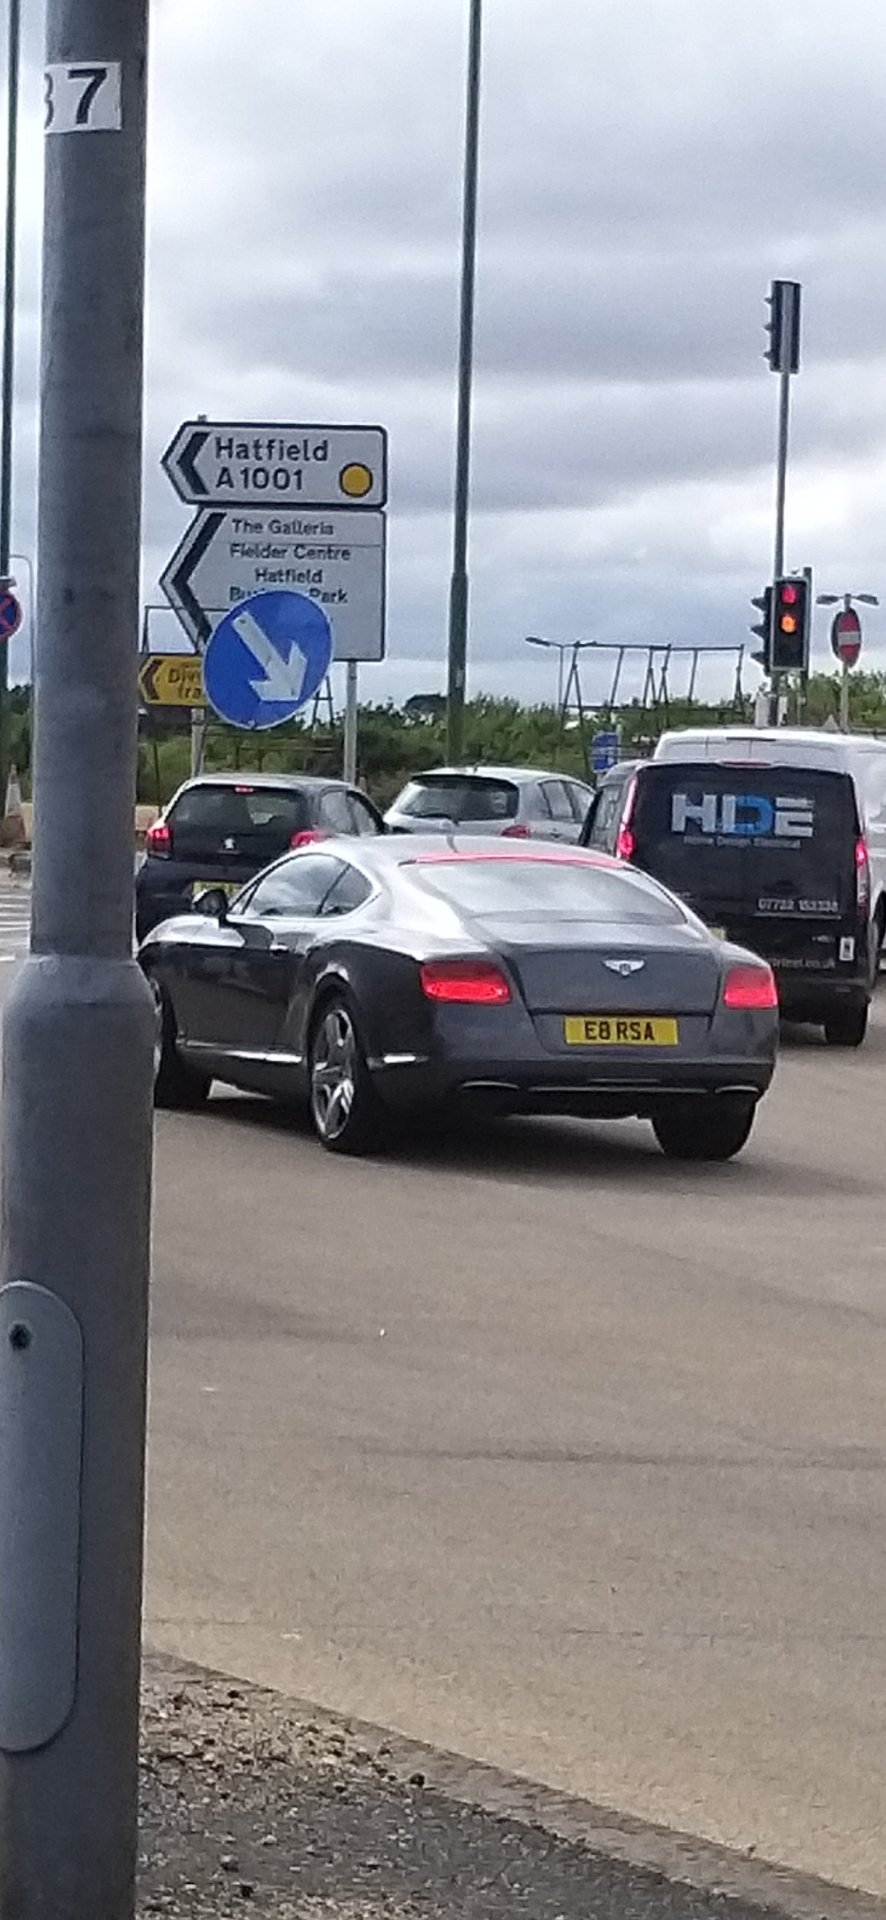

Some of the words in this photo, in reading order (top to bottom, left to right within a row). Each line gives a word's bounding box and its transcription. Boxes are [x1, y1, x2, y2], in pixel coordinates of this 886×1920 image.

[215, 437, 329, 462] Hatfield
[232, 519, 263, 534] The
[267, 519, 334, 535] Galleria
[230, 543, 287, 560] Fielder
[293, 544, 351, 561] Centre
[255, 567, 323, 584] Hatfield
[178, 683, 203, 699] tra
[671, 794, 814, 837] HDE
[584, 1021, 611, 1040] E8
[616, 1021, 655, 1041] RSA
